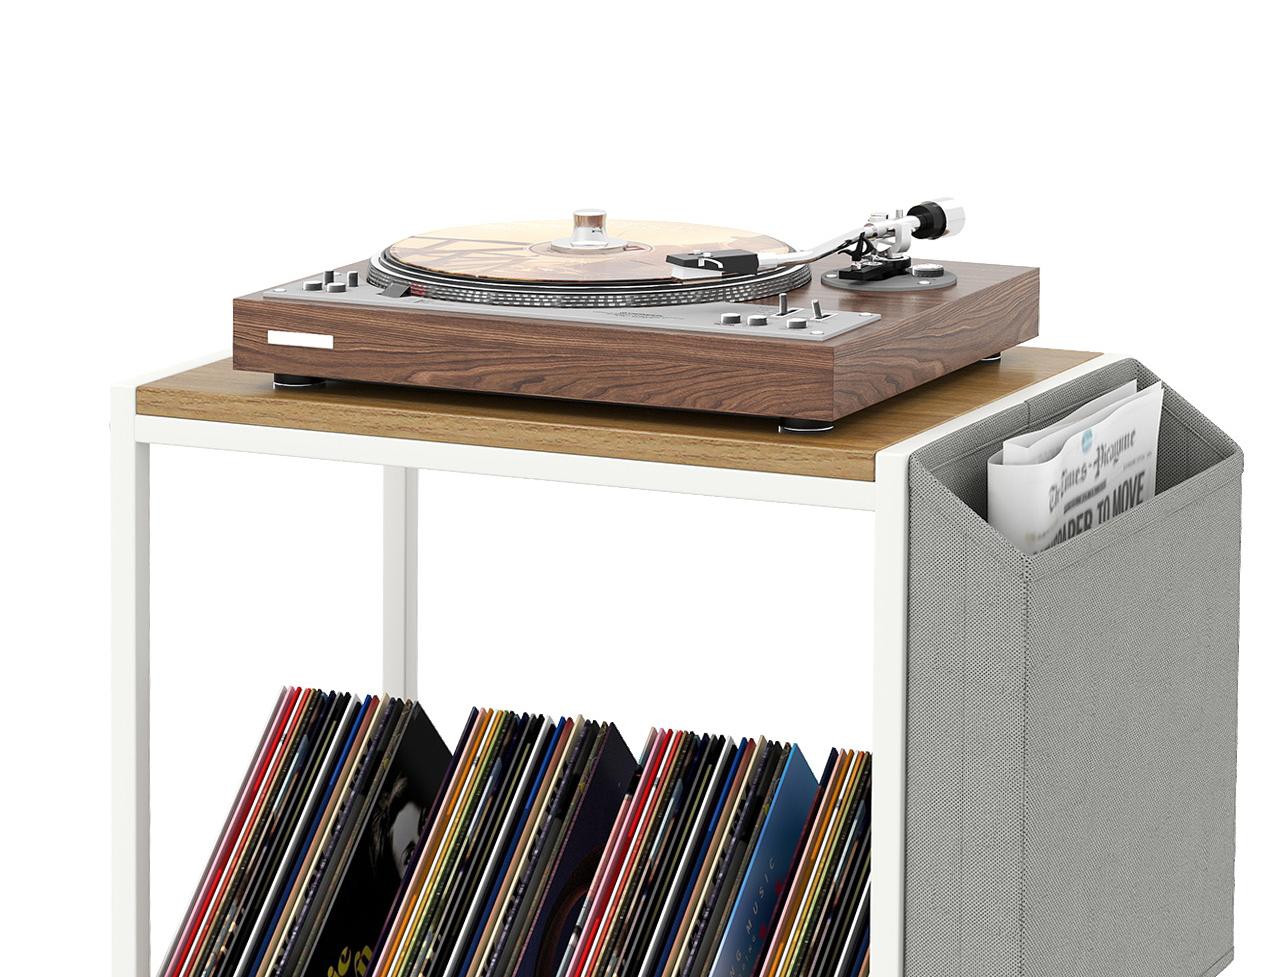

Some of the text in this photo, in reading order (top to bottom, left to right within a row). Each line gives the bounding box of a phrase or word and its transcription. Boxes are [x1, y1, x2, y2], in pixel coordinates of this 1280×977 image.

[1097, 494, 1111, 525] TO
[1112, 470, 1145, 518] MOVE
[746, 857, 775, 935] MUSIC
